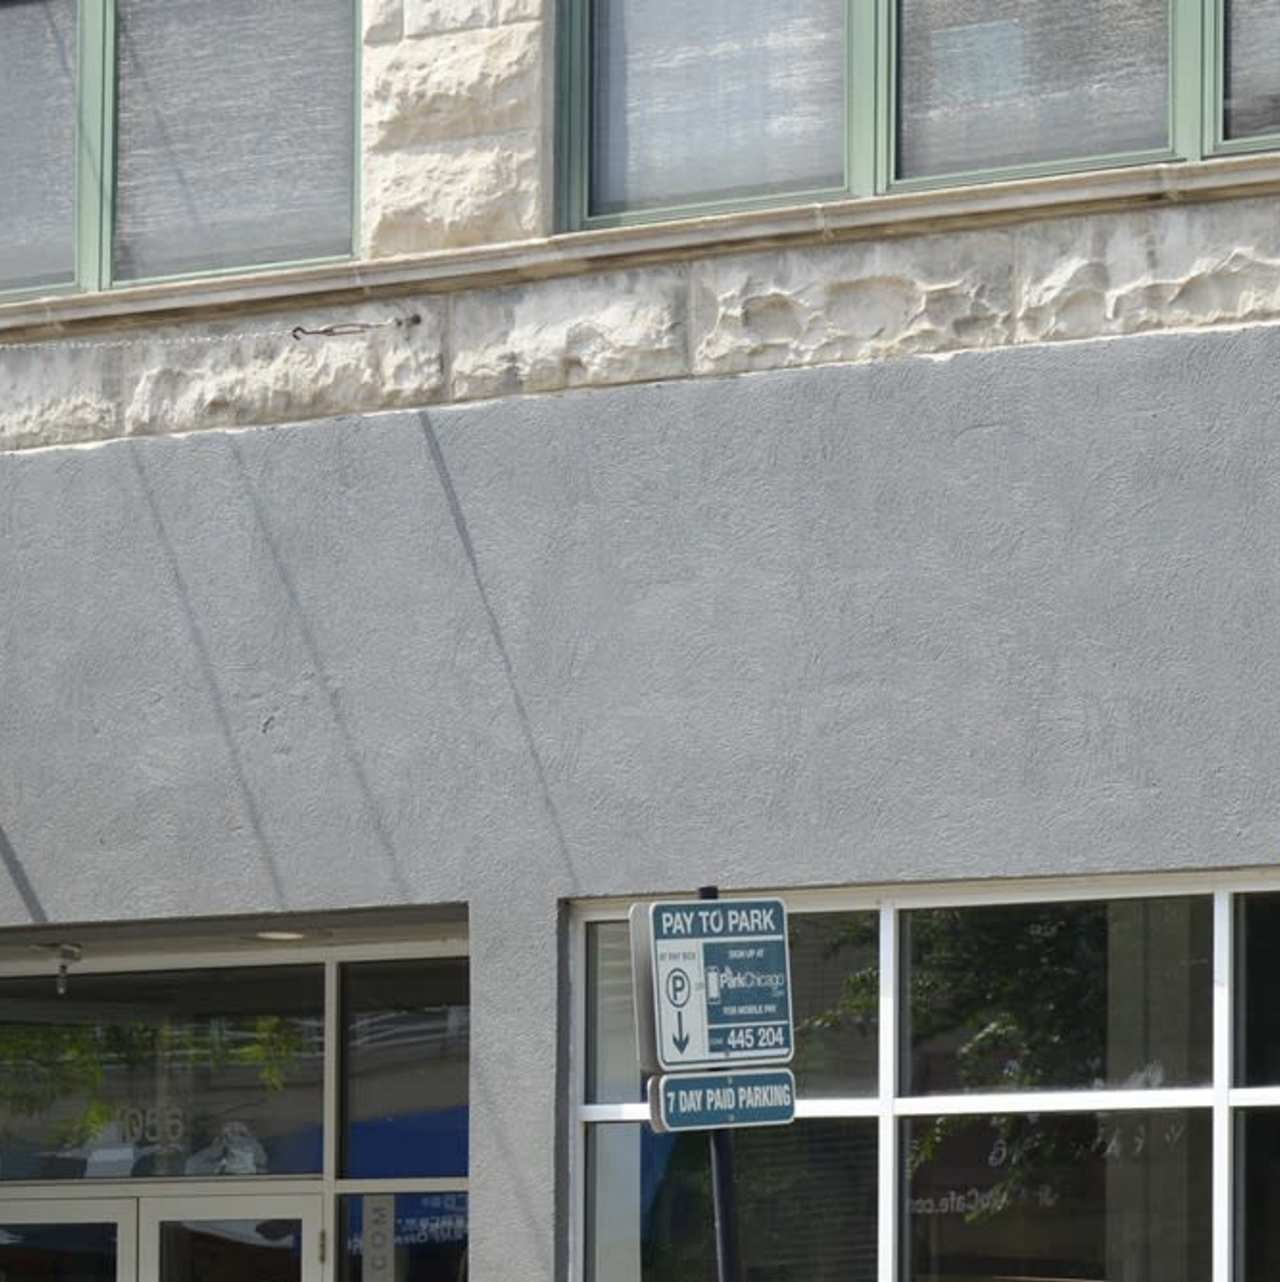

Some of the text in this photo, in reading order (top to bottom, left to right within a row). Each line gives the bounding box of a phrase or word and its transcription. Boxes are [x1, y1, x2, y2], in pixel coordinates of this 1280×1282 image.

[662, 909, 775, 934] PAY TO PARK
[727, 1028, 754, 1048] 445
[758, 1027, 784, 1047] 204
[667, 1084, 791, 1113] 7 DAY PAID PARKING
